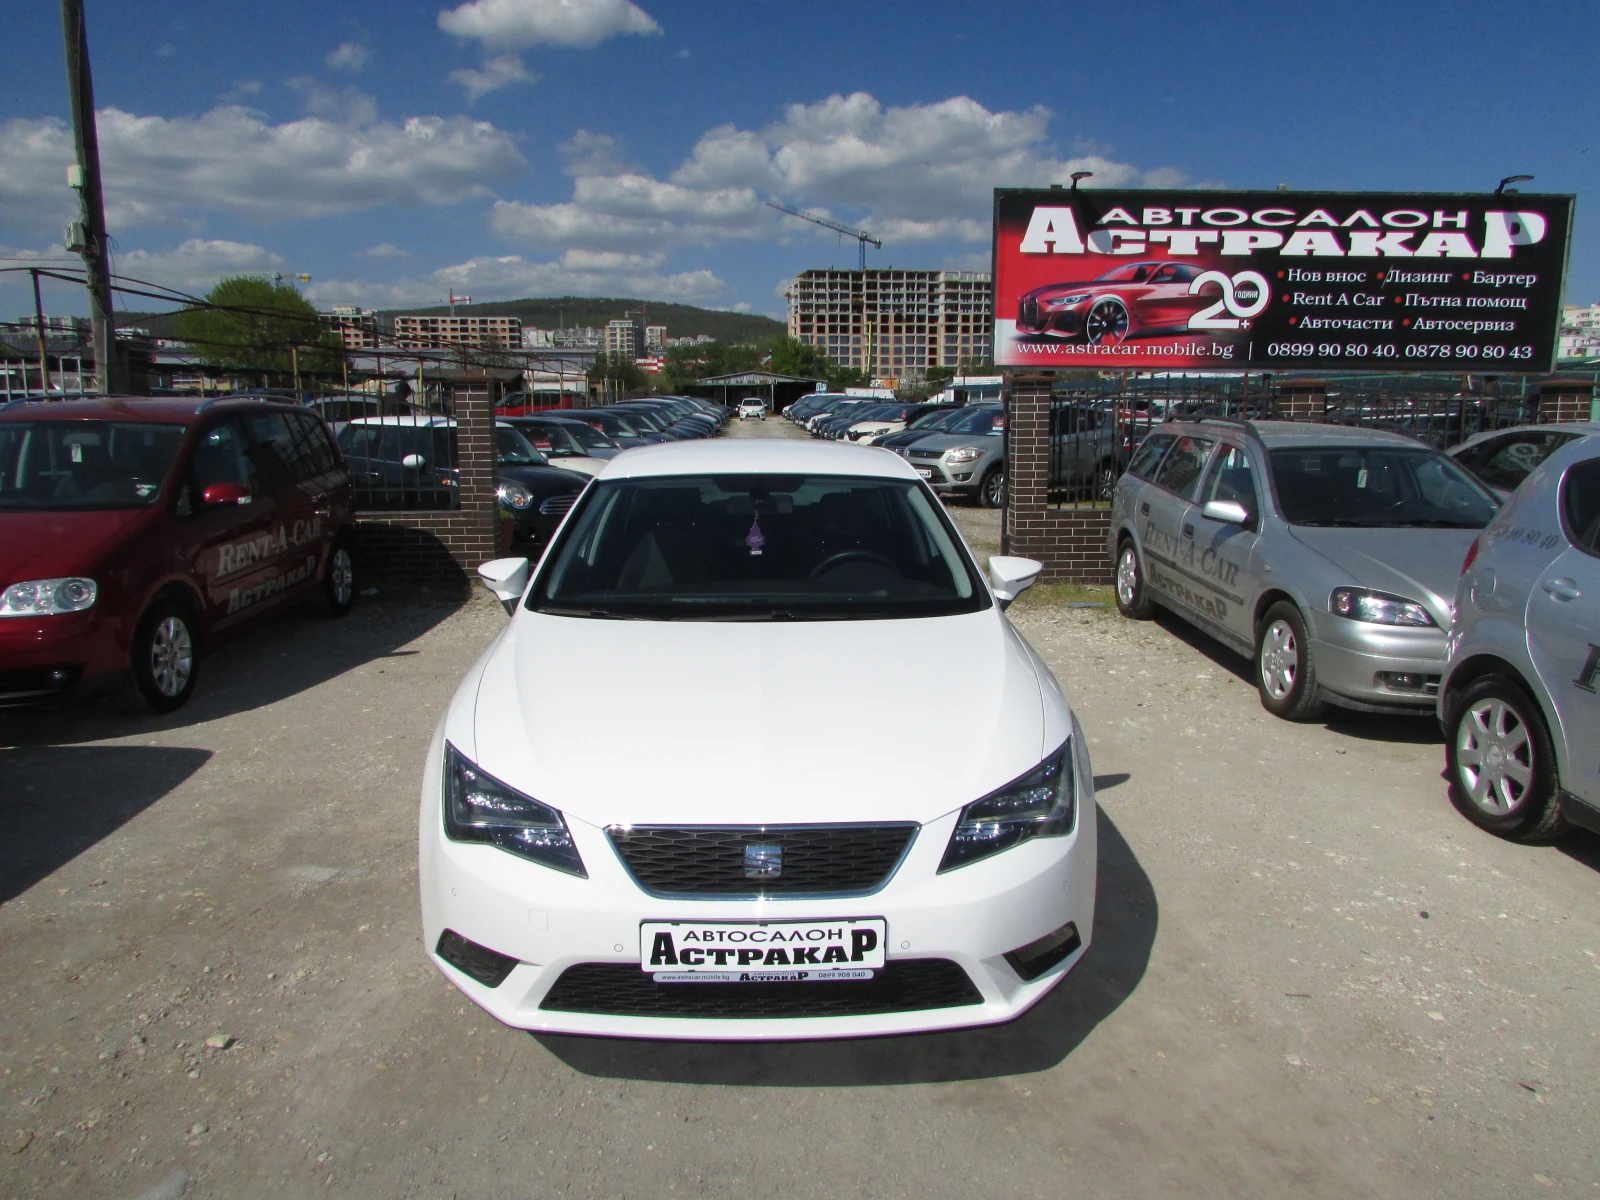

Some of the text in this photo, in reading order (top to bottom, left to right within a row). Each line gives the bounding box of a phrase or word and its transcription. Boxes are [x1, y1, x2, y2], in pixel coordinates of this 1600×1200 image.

[1095, 207, 1468, 228] АВТОСАЛОН
[1287, 269, 1367, 282] Нов внос
[1387, 269, 1453, 284] Лизинг
[1472, 271, 1537, 287] Бартер
[1292, 292, 1385, 306] Rent A Car
[1404, 293, 1527, 311] Пътна помощ
[1299, 316, 1393, 331] Авточасти
[1412, 317, 1514, 334] Автосервиз
[1016, 341, 1234, 360] www.astracar.mobile.bg
[1267, 343, 1314, 357] 0899
[1318, 343, 1341, 357] 90
[1345, 343, 1368, 357] 80
[1405, 344, 1451, 358] 0878
[1455, 345, 1478, 358] 90
[1482, 345, 1505, 358] 80
[1509, 346, 1533, 359] 43
[683, 928, 843, 943] АВТОСАЛОН
